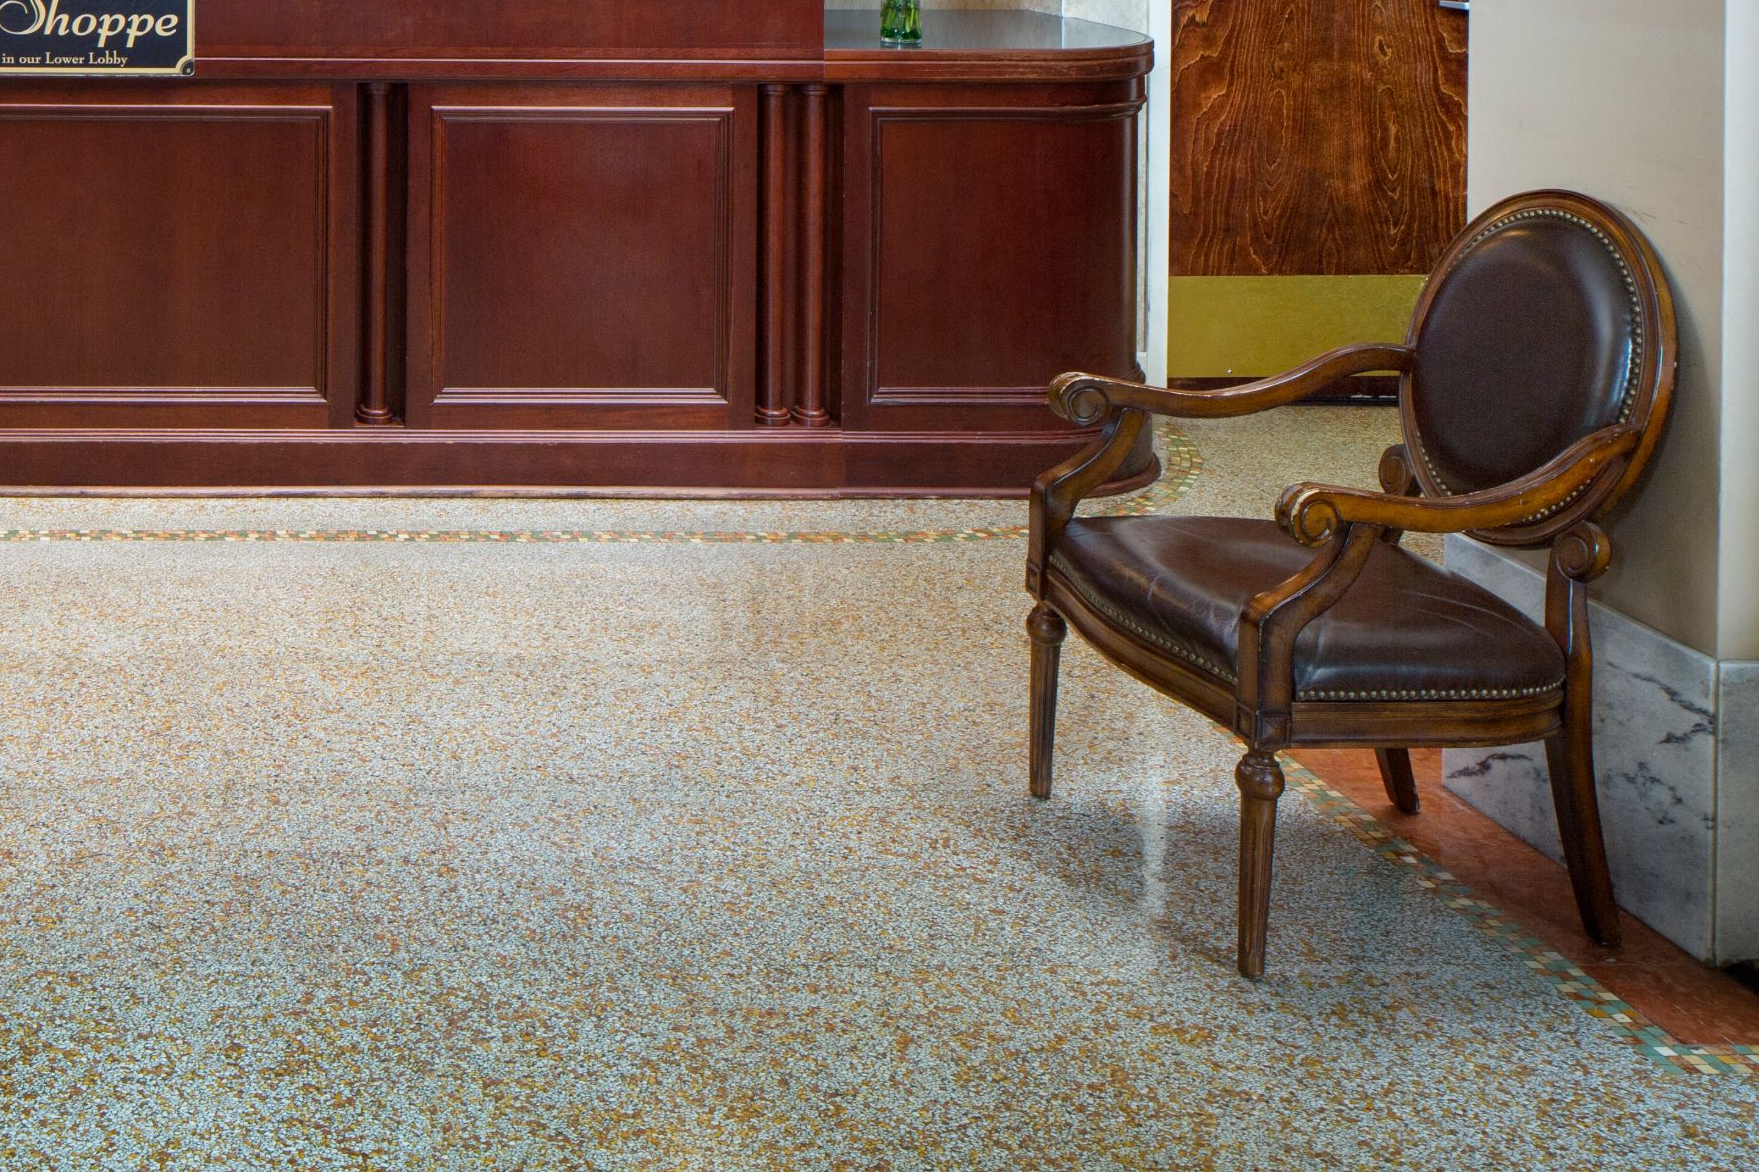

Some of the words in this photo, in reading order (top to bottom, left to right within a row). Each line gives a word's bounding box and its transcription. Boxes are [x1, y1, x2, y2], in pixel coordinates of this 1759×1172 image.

[1, 52, 15, 65] in
[18, 54, 42, 65] our
[45, 51, 85, 65] Lower
[88, 50, 129, 68] Lobby
